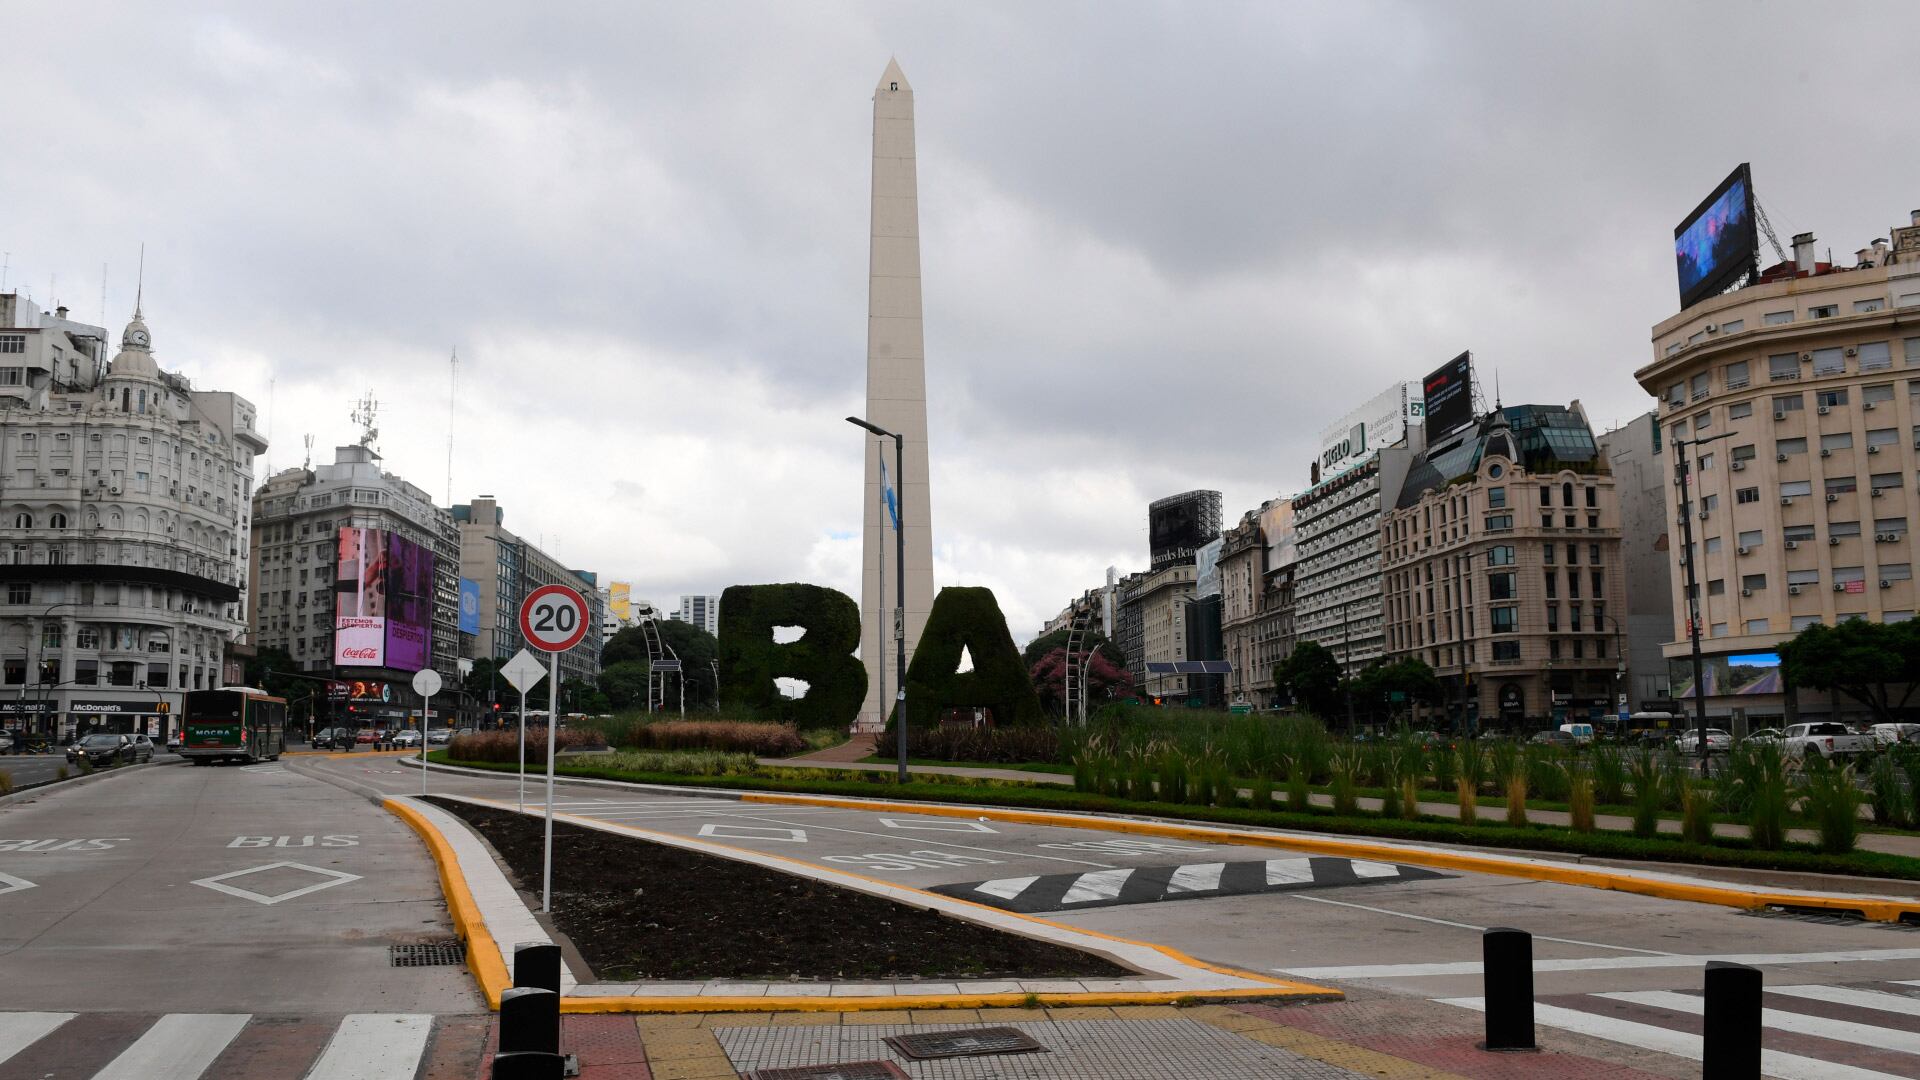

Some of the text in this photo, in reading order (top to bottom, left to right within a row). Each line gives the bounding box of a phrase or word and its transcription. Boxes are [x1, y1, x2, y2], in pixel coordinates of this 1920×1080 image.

[1323, 439, 1350, 468] SIGLO
[534, 604, 576, 632] 20
[226, 835, 360, 848] BUS
